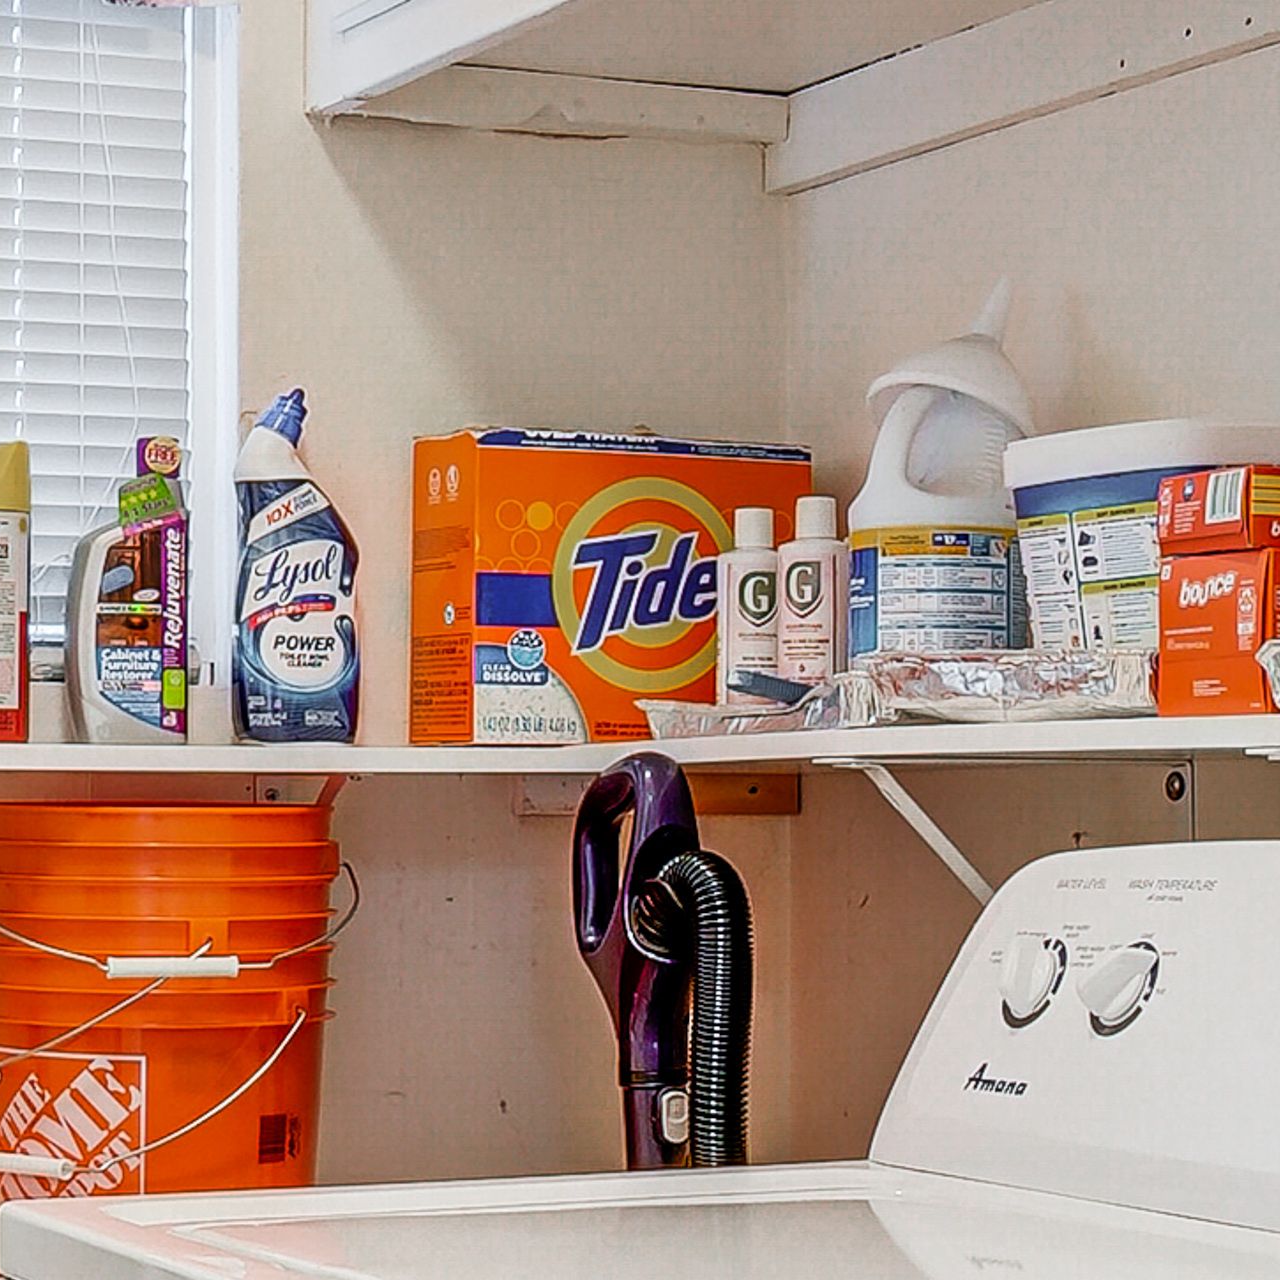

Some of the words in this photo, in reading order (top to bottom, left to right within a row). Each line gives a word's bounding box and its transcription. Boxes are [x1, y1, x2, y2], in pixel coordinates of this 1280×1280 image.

[266, 499, 294, 526] 10X
[163, 527, 183, 649] Rejuvenate
[253, 545, 337, 602] Lysol
[789, 566, 813, 602] G
[571, 529, 718, 656] Tide
[734, 576, 768, 612] G
[1180, 573, 1235, 608] bounce
[101, 648, 150, 661] Cabinet
[273, 635, 335, 651] POWER
[101, 660, 159, 671] Furniture
[101, 670, 154, 680] Restorer
[482, 671, 542, 683] DISSOLVE
[964, 1063, 1028, 1096] Amana
